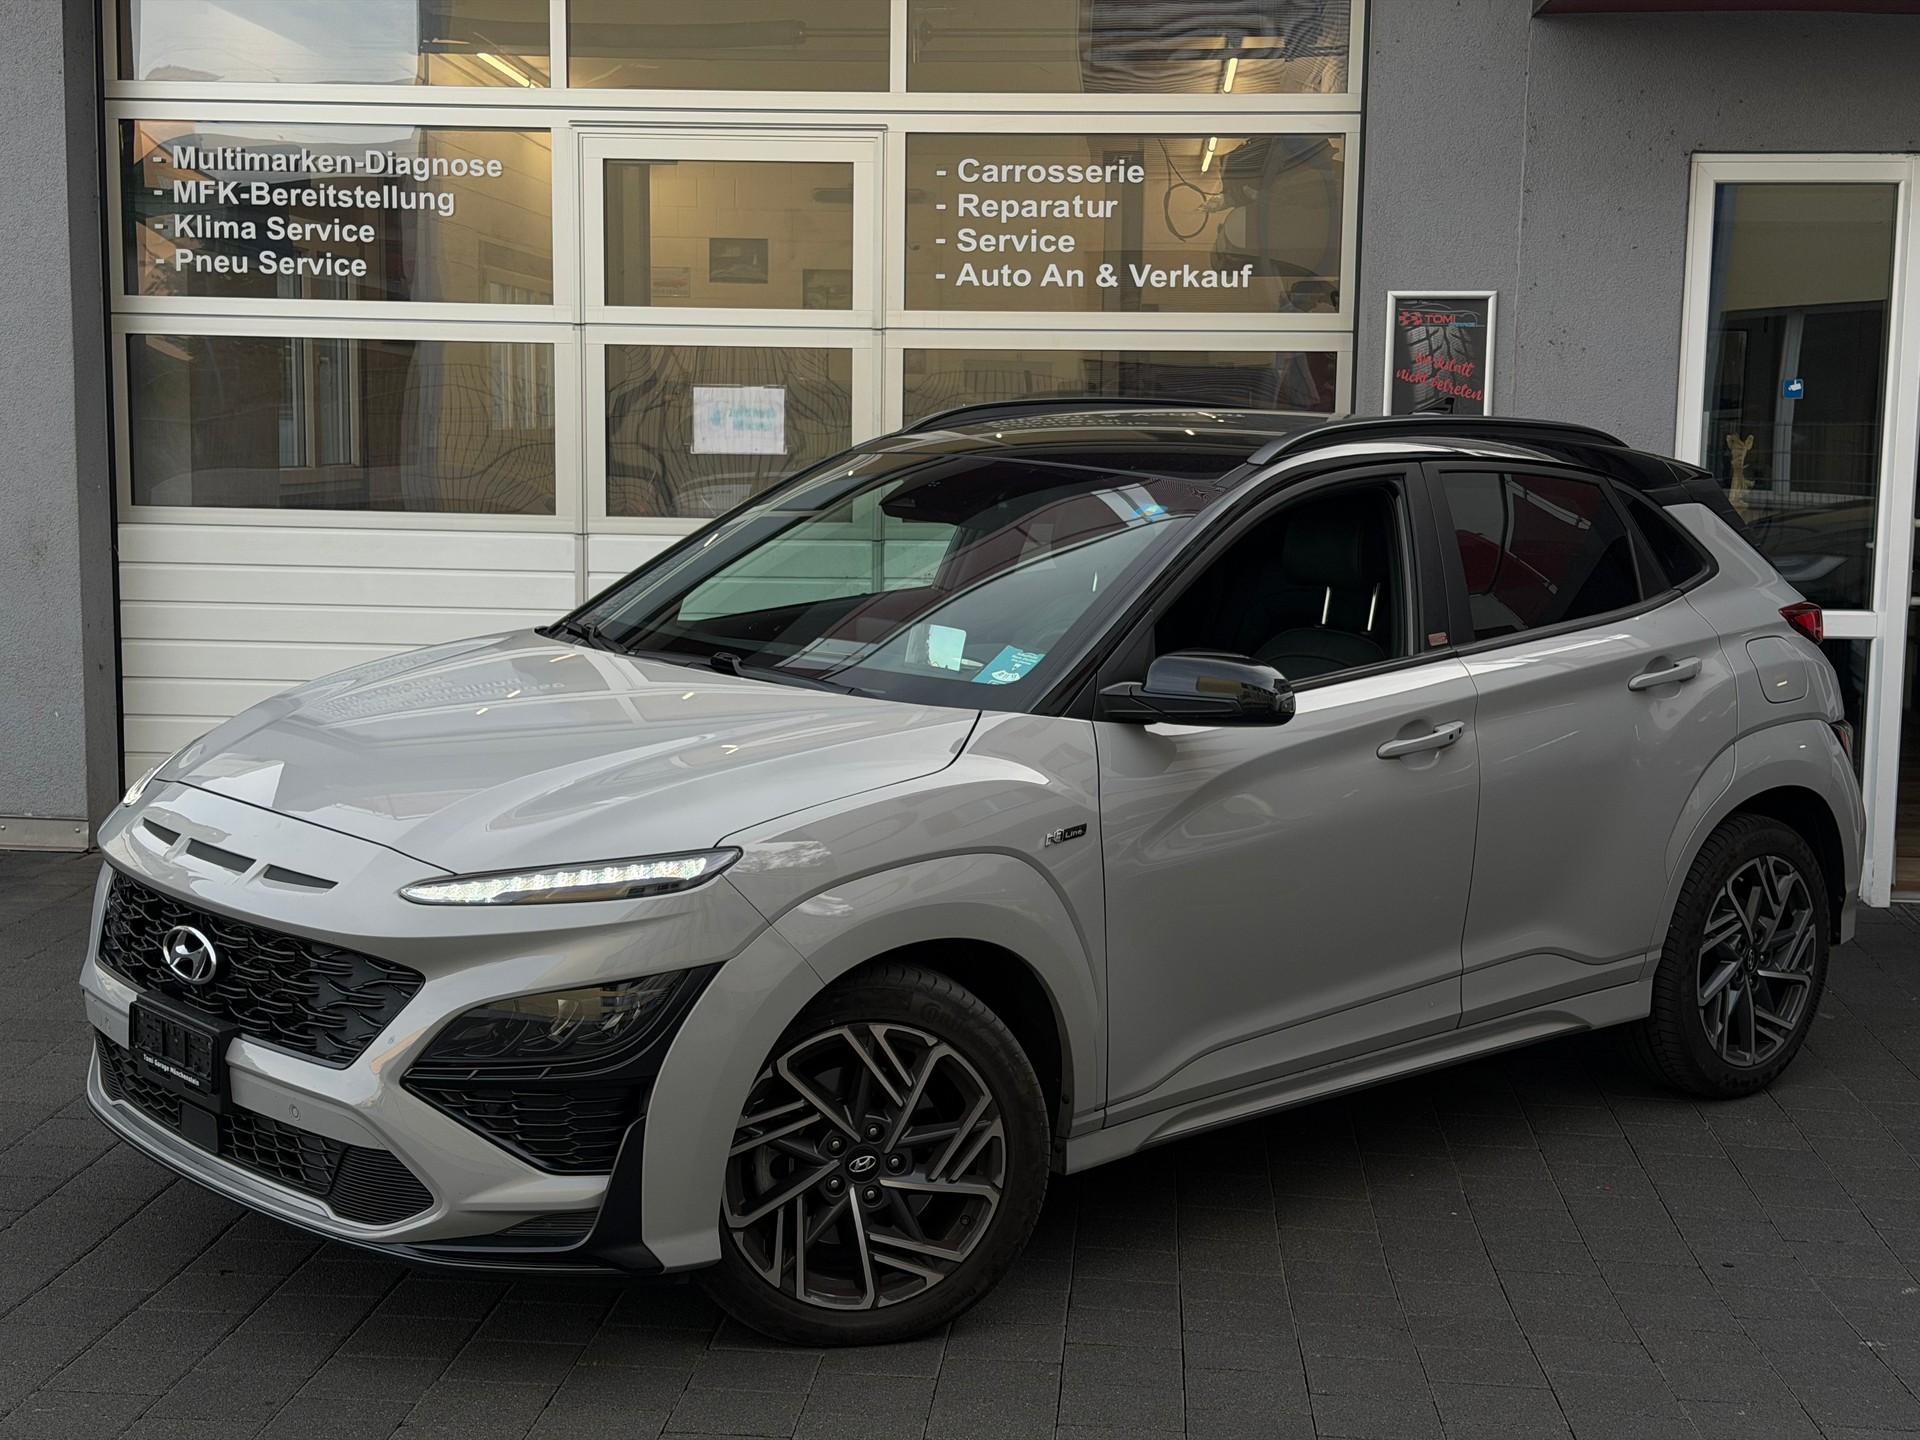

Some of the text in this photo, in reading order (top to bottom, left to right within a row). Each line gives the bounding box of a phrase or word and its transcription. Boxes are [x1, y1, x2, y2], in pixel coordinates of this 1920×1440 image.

[172, 146, 503, 181] Multimarken-Diagnose
[957, 158, 1145, 183] Carrosserie
[173, 180, 456, 217] MFK-Bereitstellung
[958, 193, 1118, 224] Reparatur
[174, 214, 256, 240] Klima
[266, 216, 375, 243] Service
[956, 228, 1075, 253] Service
[175, 248, 248, 273] Pneu
[259, 250, 367, 277] Service
[955, 262, 1032, 288] Auto
[1040, 263, 1084, 287] An
[1095, 263, 1119, 288] &
[1128, 263, 1254, 288] Verkauf
[1425, 314, 1456, 324] TOMI
[1396, 368, 1484, 400] nicht betreten
